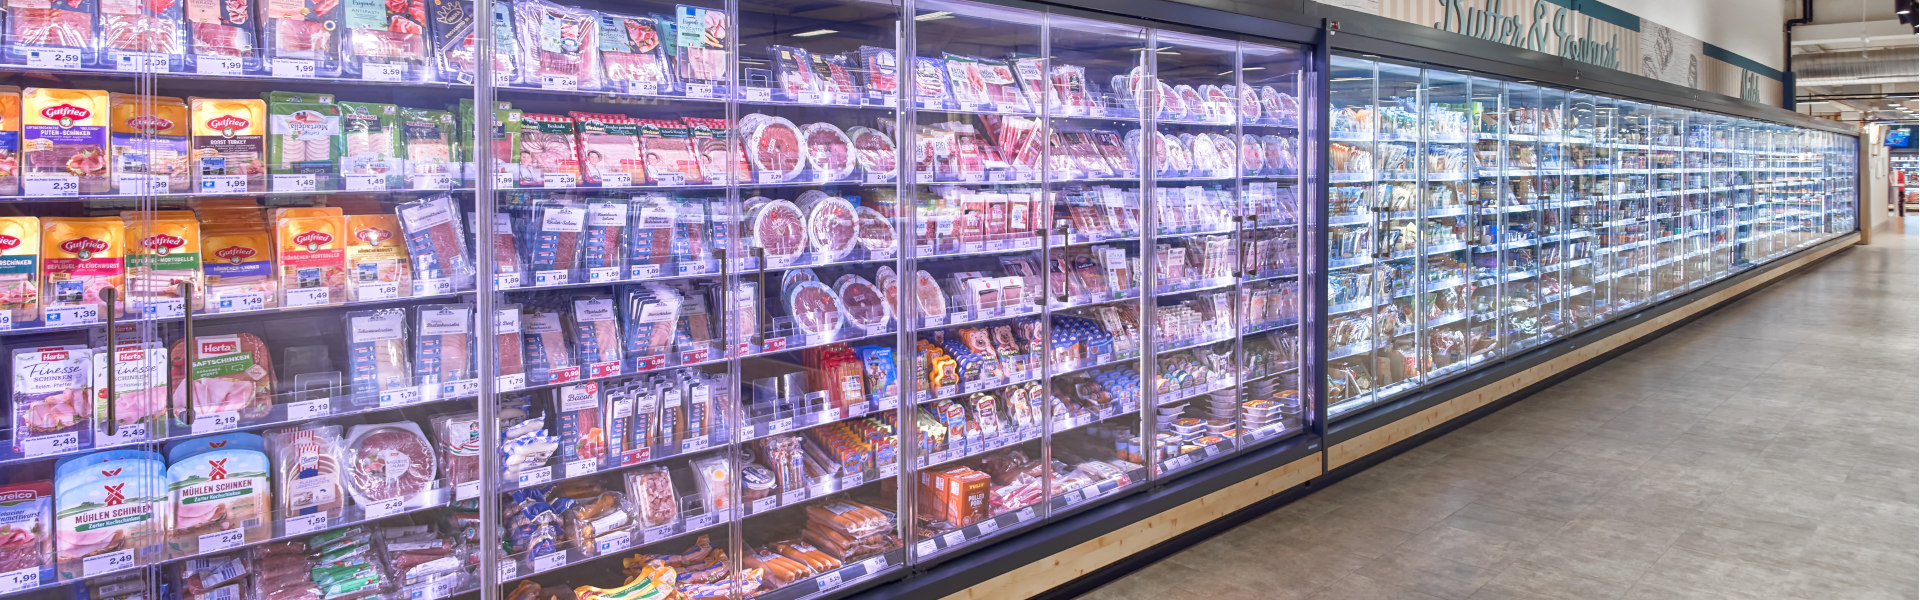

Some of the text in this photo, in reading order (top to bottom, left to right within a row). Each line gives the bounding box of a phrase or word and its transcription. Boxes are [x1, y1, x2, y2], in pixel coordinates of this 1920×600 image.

[1527, 0, 1549, 53] &
[55, 54, 79, 63] 2,59
[221, 62, 241, 70] 1,99
[295, 65, 314, 73] 1,99
[382, 68, 400, 76] 3,59
[46, 106, 88, 119] Gutfried
[211, 118, 247, 130] Gutfried
[295, 179, 314, 187] 1,49
[367, 178, 384, 186] 1,49
[433, 177, 450, 185] 1,49
[560, 176, 575, 184] 2,39
[617, 175, 631, 183] 1,79
[53, 182, 77, 191] 2,39
[296, 233, 331, 244] Gutfried
[64, 240, 106, 252] Gutfried
[218, 247, 254, 258] Gutfried
[504, 277, 520, 285] 1,89
[379, 286, 397, 295] 1,89
[243, 297, 263, 306] 1,49
[309, 292, 328, 301] 1,49
[73, 310, 96, 319] 1,39
[204, 343, 231, 354] Herta
[43, 353, 66, 362] Herta
[192, 353, 251, 368] SAFTSCHINKEN
[24, 362, 82, 378] Finesse
[103, 363, 157, 376] inesse
[33, 374, 73, 384] SCHINKEN
[509, 377, 524, 386] 1,79
[462, 382, 478, 391] 1,79
[400, 390, 417, 399] 1,79
[567, 393, 593, 403] Bacon
[309, 403, 328, 412] 2,19
[215, 416, 236, 426] 2,19
[122, 428, 145, 439] 2,49
[53, 437, 77, 448] 2,49
[581, 461, 596, 470] 2,19
[535, 470, 551, 480] 3,29
[182, 479, 253, 498] MÜHLEN SCHINKEN
[385, 500, 403, 511] 2,49
[75, 503, 152, 524] MÜHLEN SCHINKEN
[307, 516, 326, 526] 1,59
[222, 533, 243, 544] 2,49
[616, 537, 630, 547] 1,49
[109, 554, 133, 566] 2,49
[12, 572, 37, 585] 1,99
